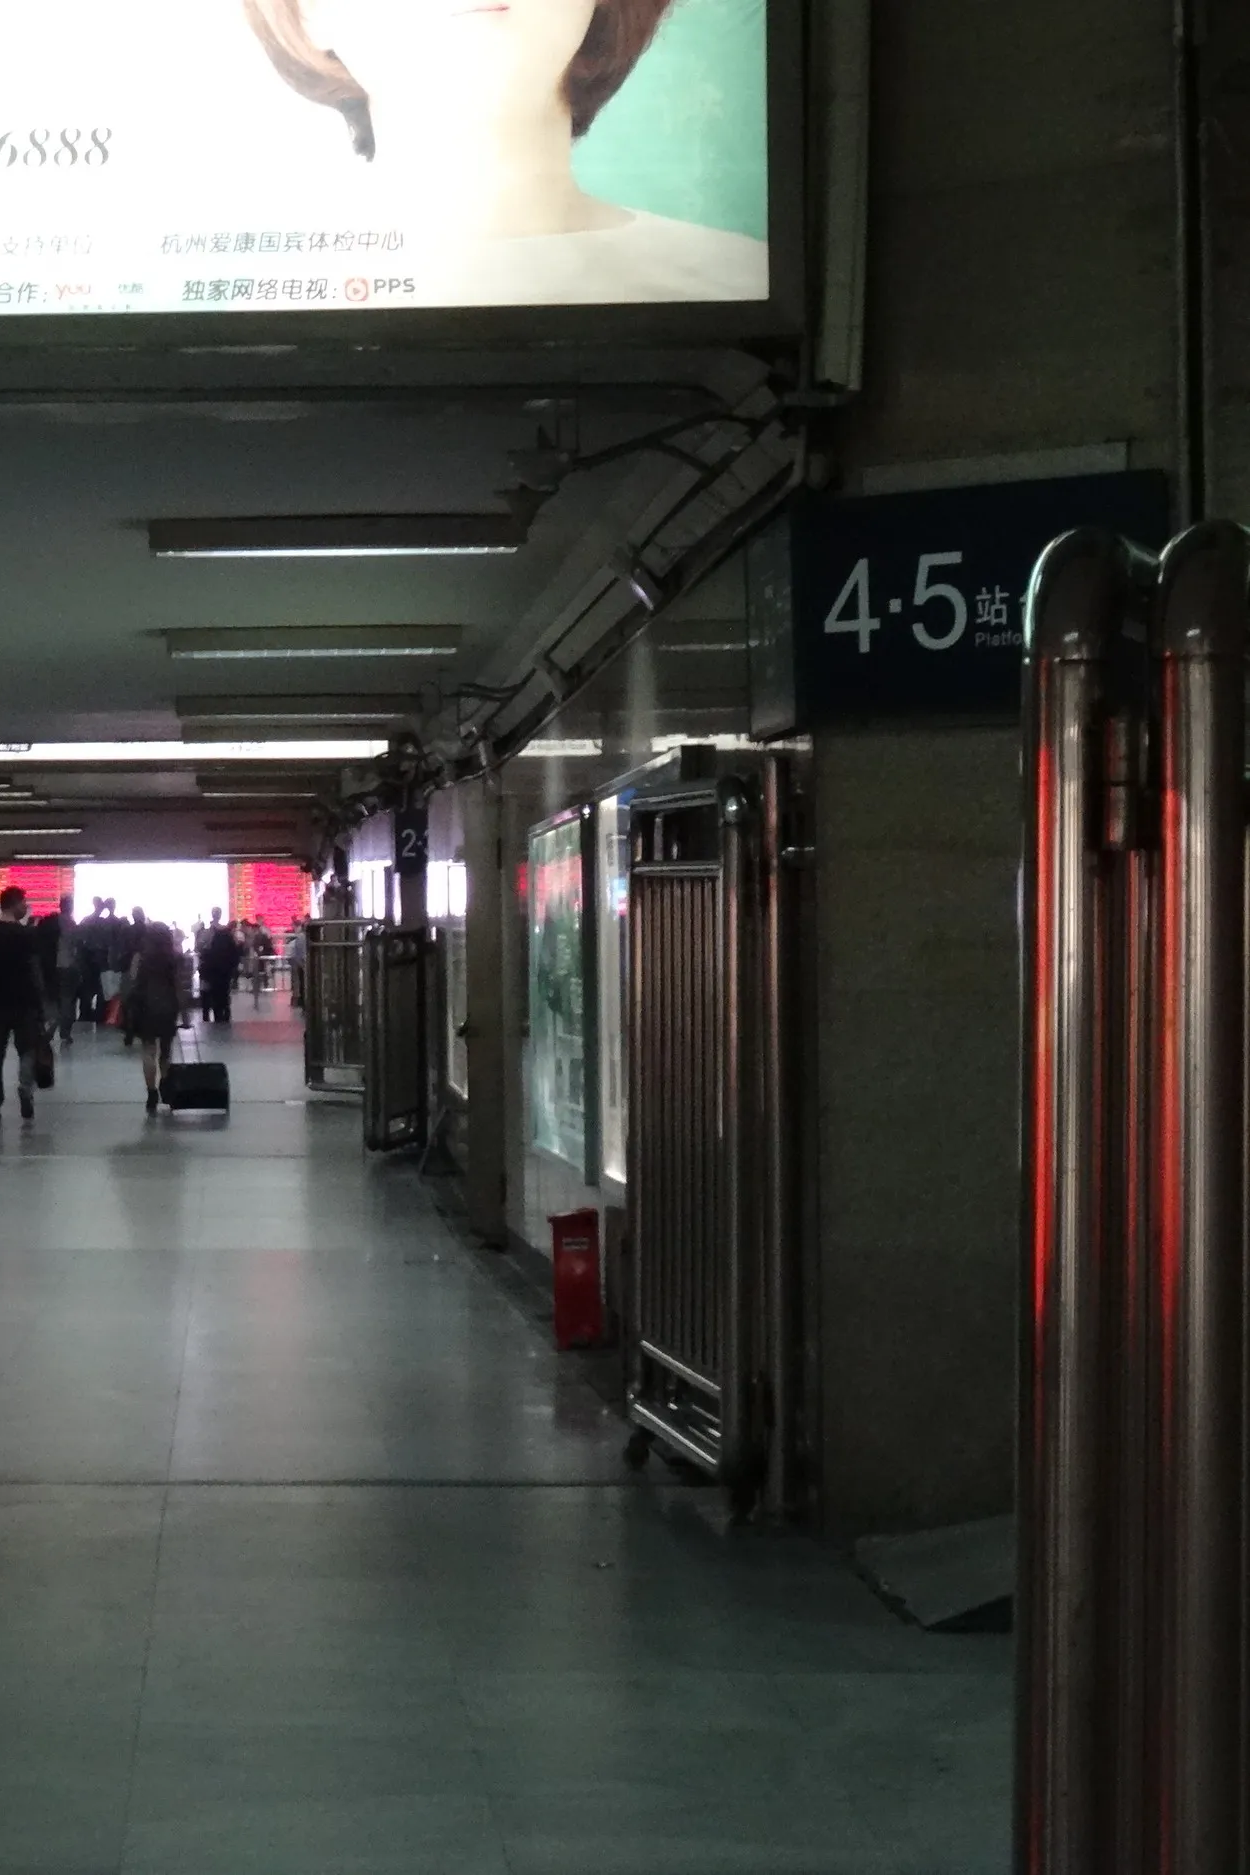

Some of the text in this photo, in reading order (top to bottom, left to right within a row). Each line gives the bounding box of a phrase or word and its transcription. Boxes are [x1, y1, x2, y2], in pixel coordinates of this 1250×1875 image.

[159, 230, 405, 255] 杭州爱康国宾体检中心
[181, 278, 417, 302] 独家网络电视： PPS
[974, 584, 1027, 627] 站
[974, 629, 1024, 648] Platfo
